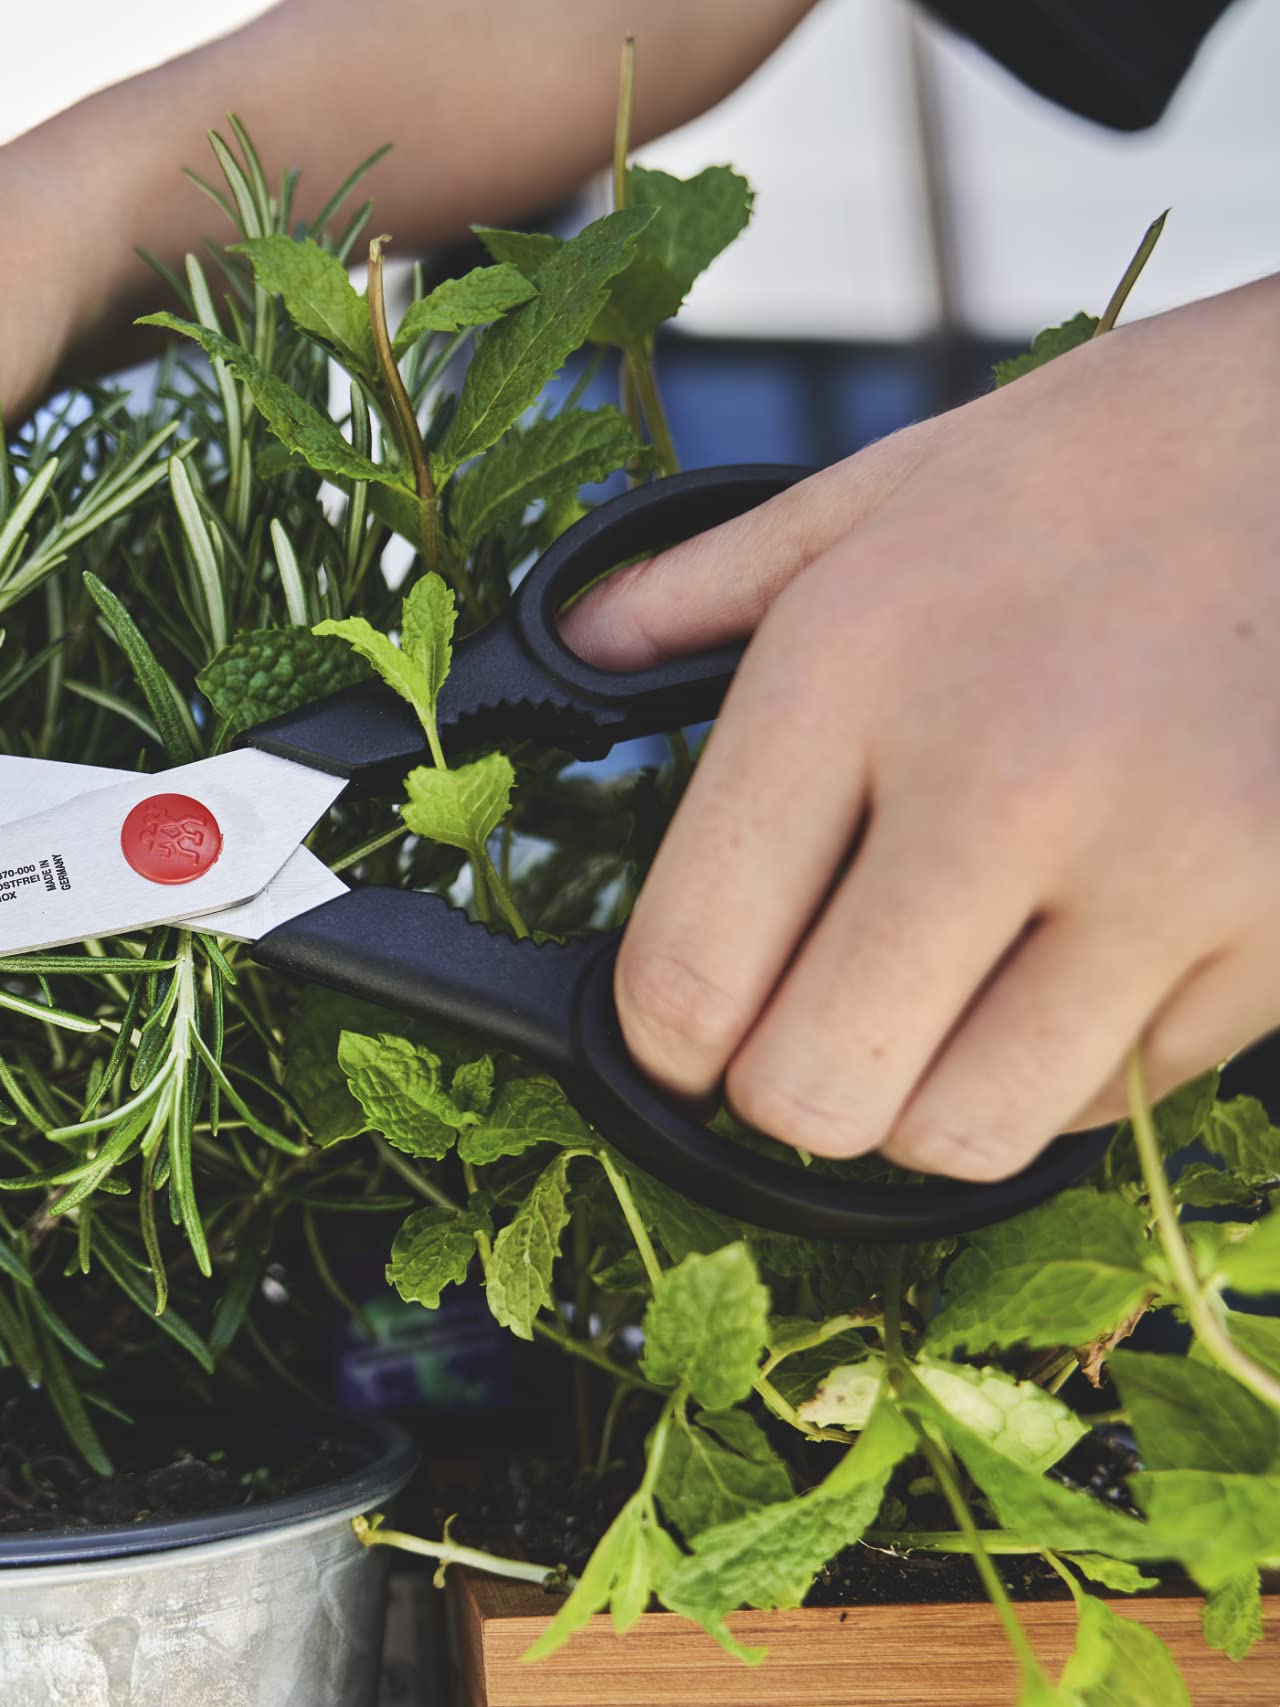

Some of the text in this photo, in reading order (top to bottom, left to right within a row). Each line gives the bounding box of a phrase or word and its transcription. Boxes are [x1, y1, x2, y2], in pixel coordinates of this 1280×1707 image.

[38, 859, 57, 892] MADE IN
[51, 854, 71, 891] GERMANY
